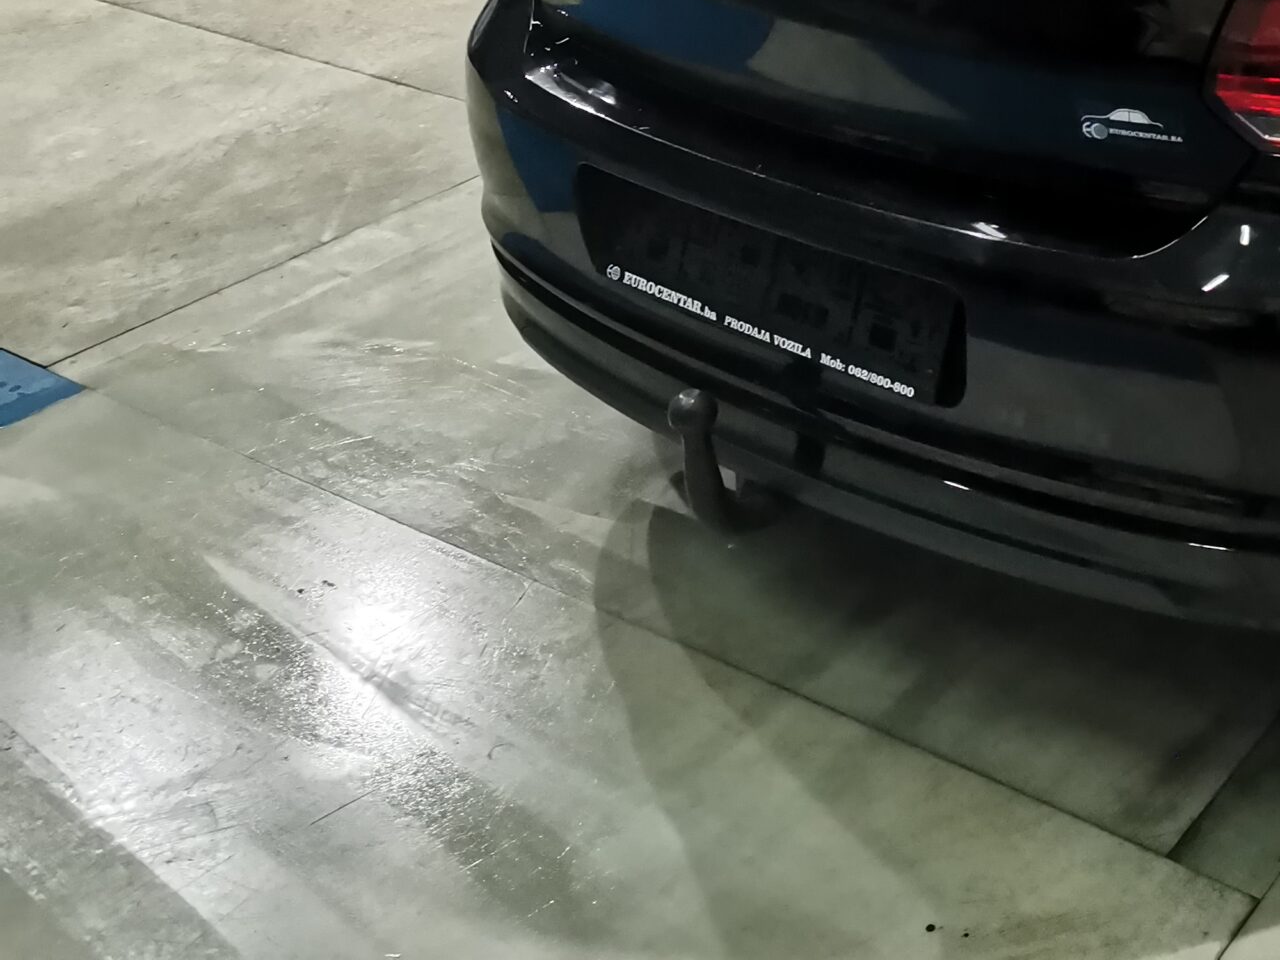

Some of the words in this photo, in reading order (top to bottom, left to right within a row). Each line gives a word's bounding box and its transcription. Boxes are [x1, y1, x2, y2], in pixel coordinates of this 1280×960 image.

[622, 271, 718, 321] EUROCENTAR.ba
[723, 315, 771, 344] PRODAJA
[773, 334, 813, 360] VOZILA
[819, 352, 846, 372] Mob:
